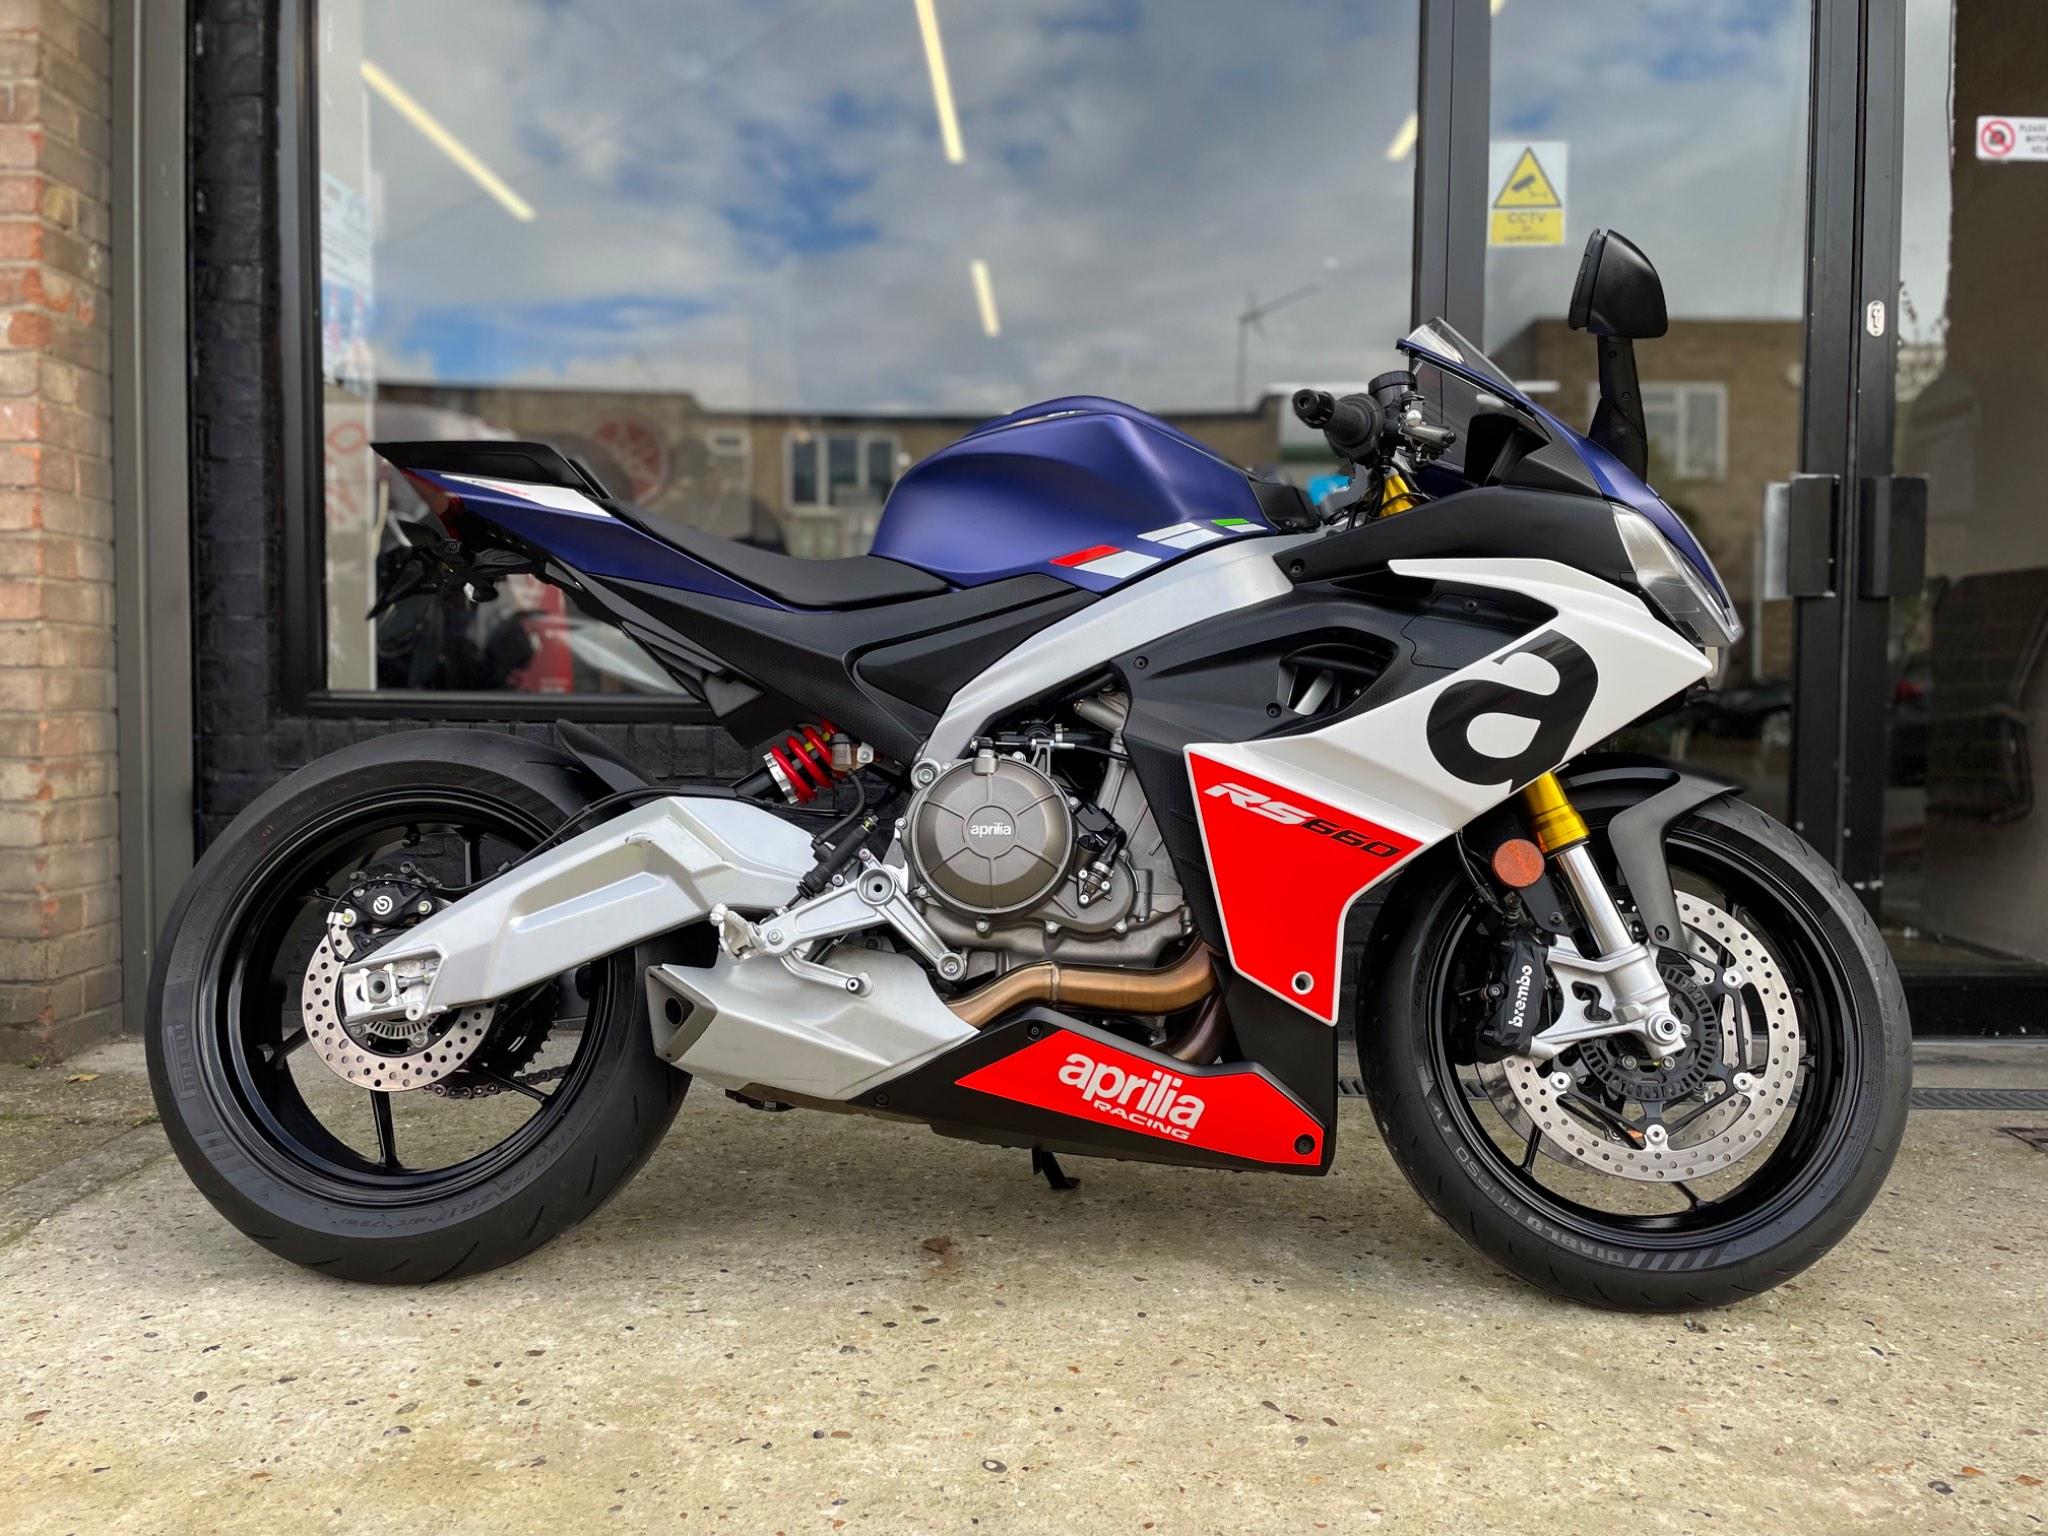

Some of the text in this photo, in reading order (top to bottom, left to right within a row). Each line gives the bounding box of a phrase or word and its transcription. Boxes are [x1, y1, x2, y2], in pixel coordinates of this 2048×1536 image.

[1507, 212, 1547, 224] CCTV
[970, 821, 1012, 838] aprilia
[1508, 965, 1533, 1028] brembo
[1058, 1053, 1205, 1129] aprilia
[1093, 1100, 1191, 1140] RACING
[1455, 1146, 1522, 1217] ROSSO
[1525, 1215, 1625, 1265] DIABLO
